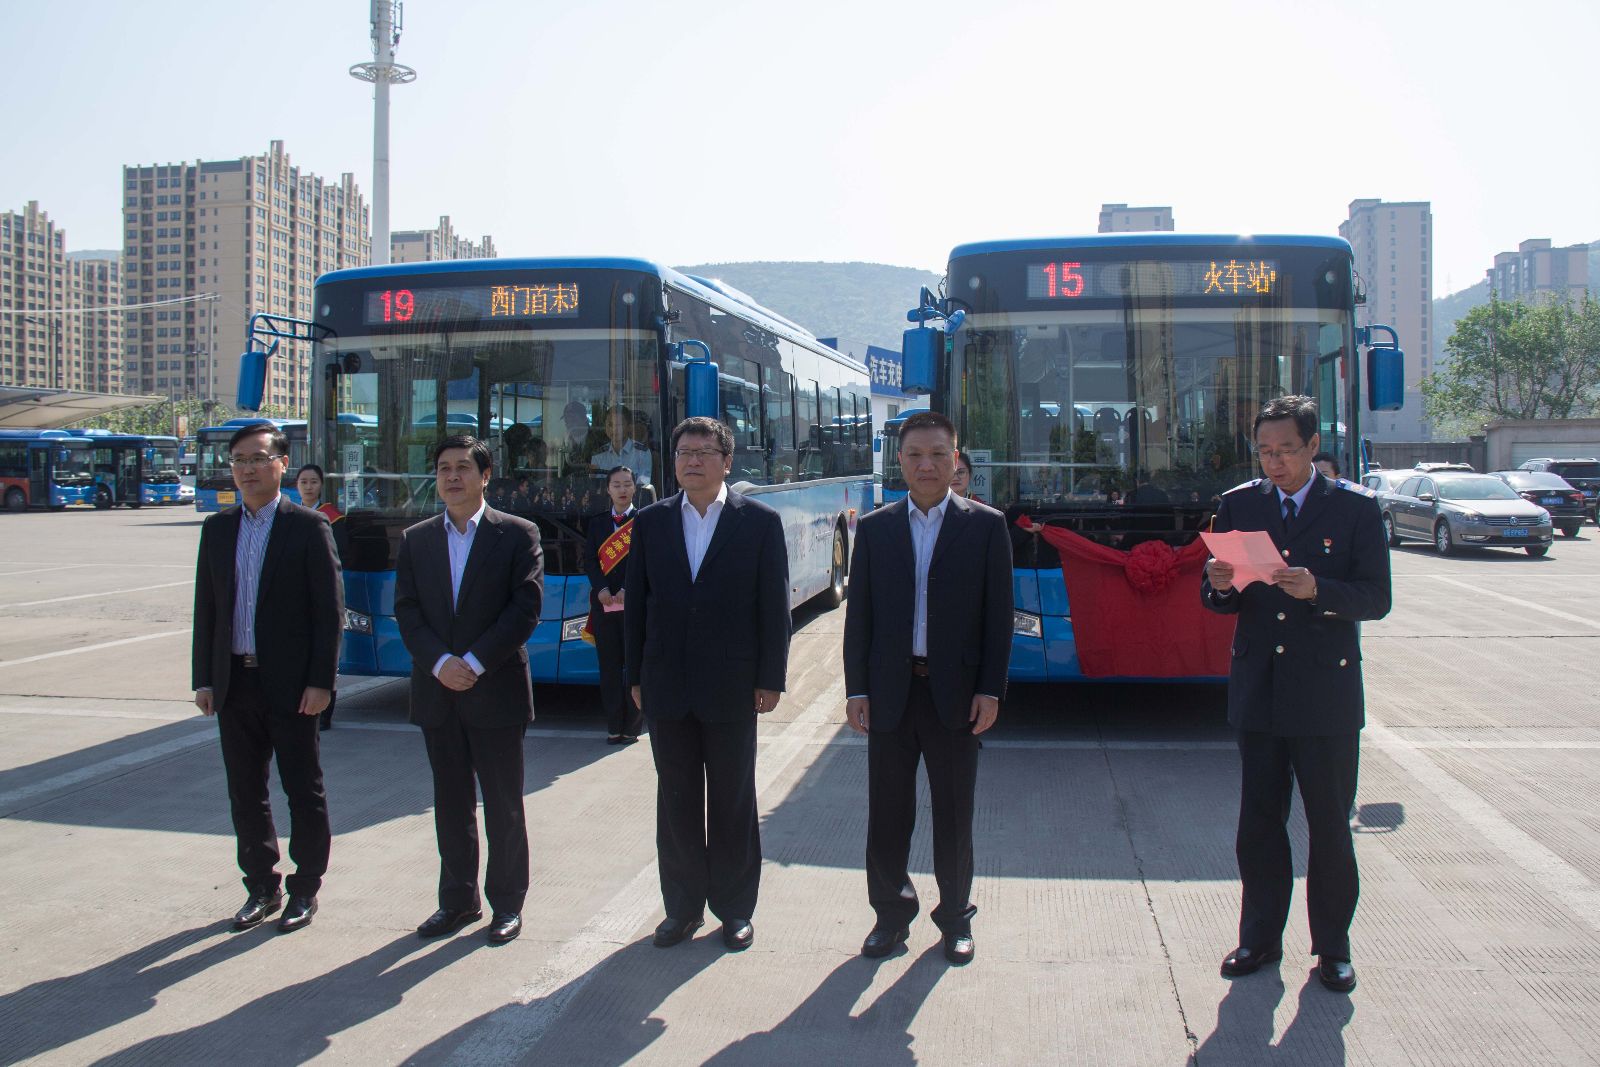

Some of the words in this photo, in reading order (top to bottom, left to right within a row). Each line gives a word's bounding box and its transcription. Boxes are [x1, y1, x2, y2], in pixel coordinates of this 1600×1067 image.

[1043, 261, 1084, 297] 15
[1203, 259, 1276, 294] 火车站
[380, 289, 415, 322] 19
